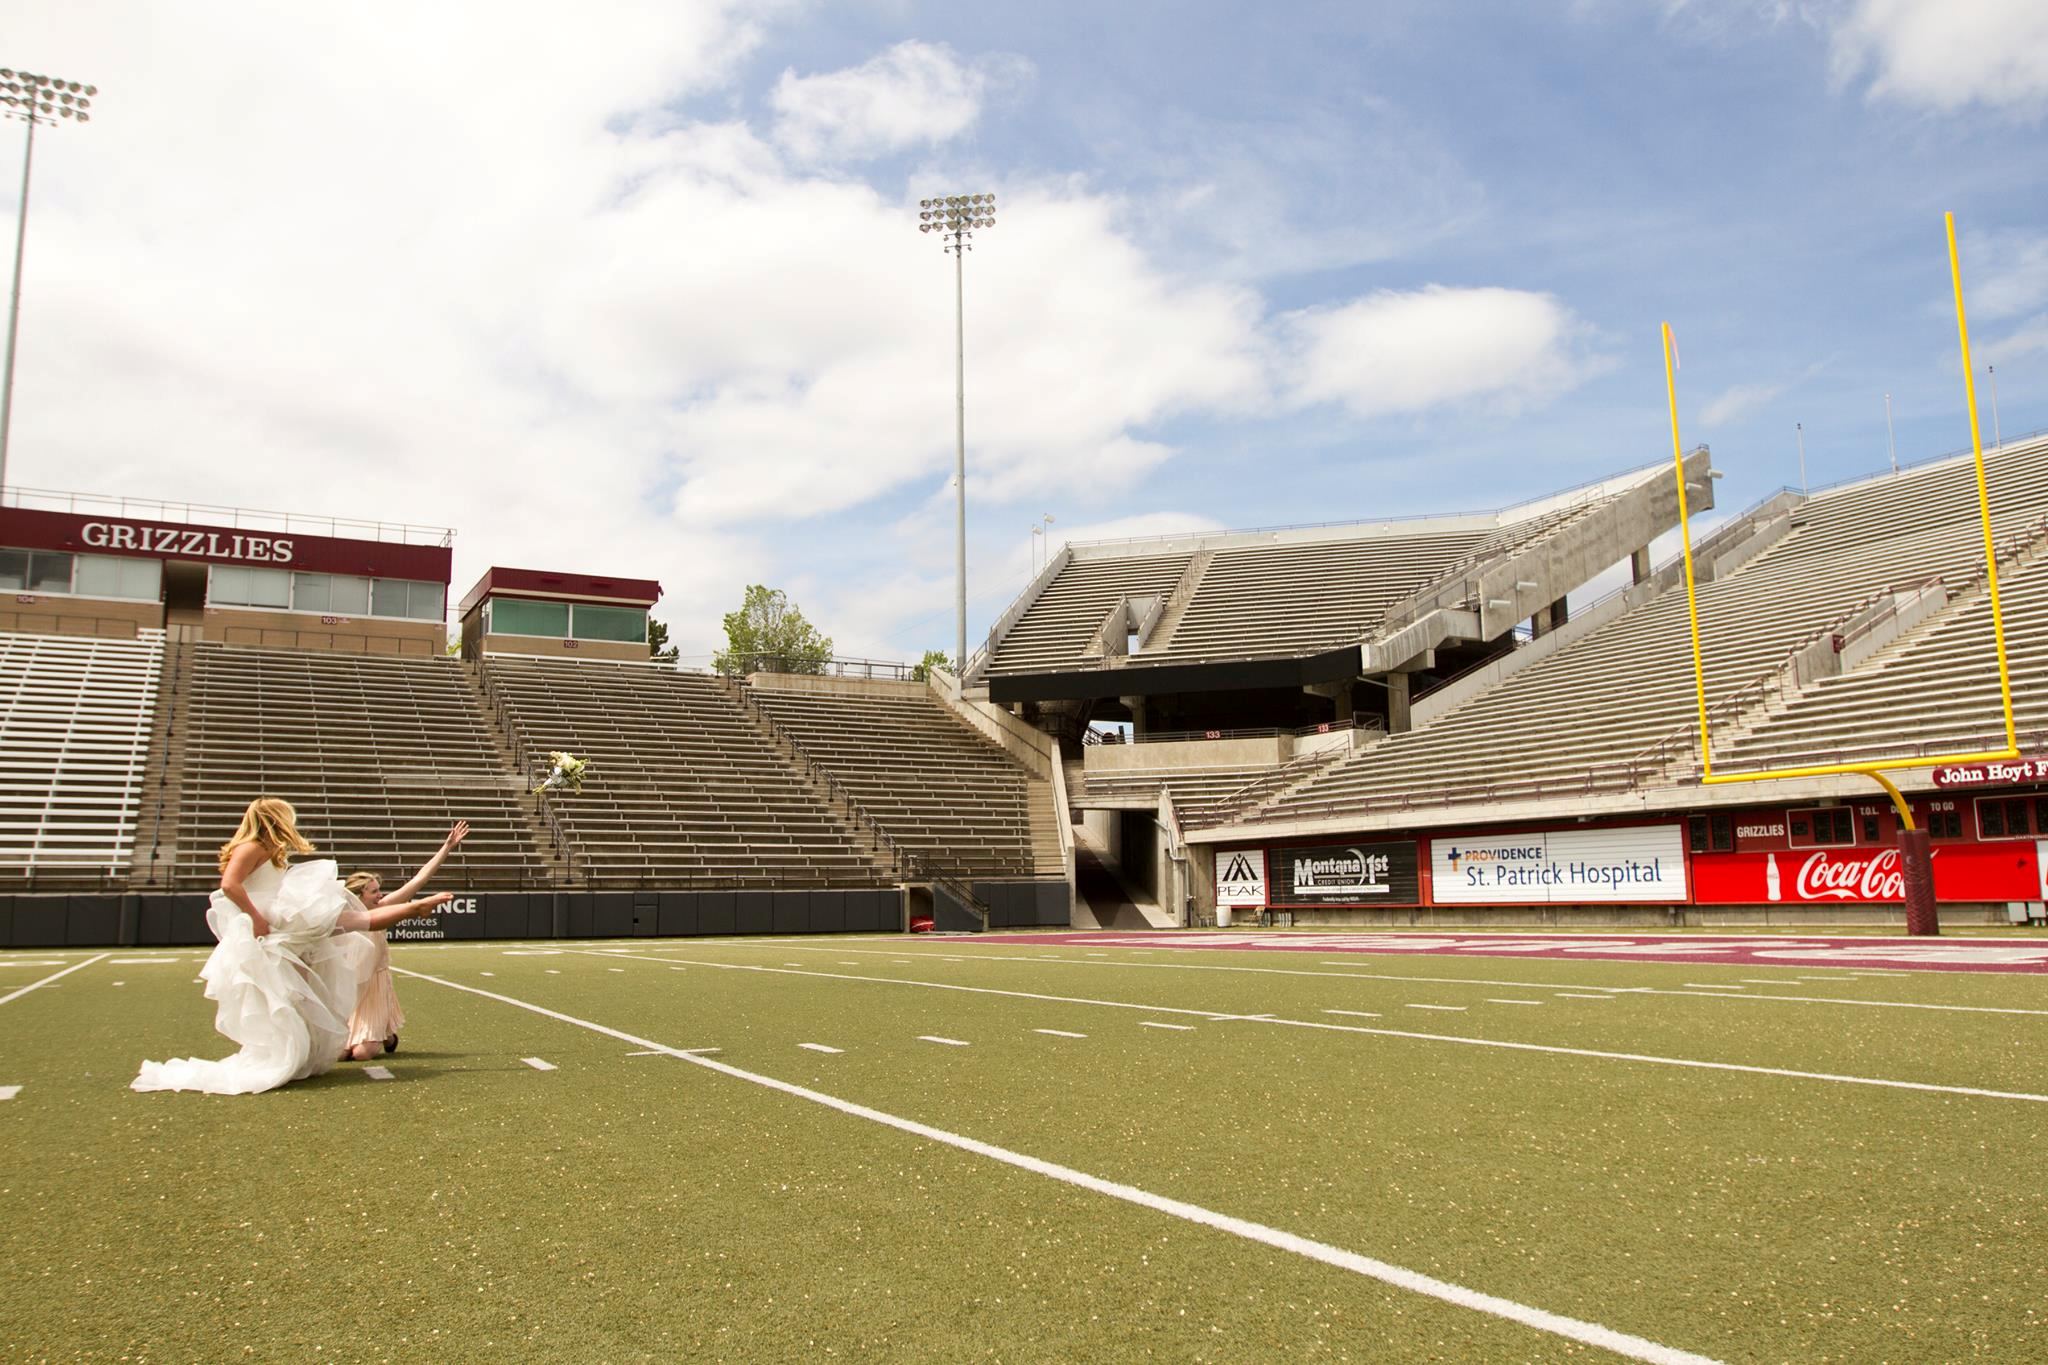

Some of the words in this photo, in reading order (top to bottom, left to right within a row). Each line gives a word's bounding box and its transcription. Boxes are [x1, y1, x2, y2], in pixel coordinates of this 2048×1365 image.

[81, 522, 294, 562] GRIZZLIES
[322, 617, 337, 625] 103
[1205, 730, 1221, 739] 133
[1318, 723, 1329, 733] 133
[1940, 767, 1984, 783] John
[1987, 762, 2032, 782] Hoyt
[1930, 802, 1941, 812] TO
[1943, 802, 1955, 811] GO
[1737, 824, 1784, 838] GRIZZLIES
[1465, 847, 1543, 861] PROVIDENCE
[1294, 857, 1360, 886] Montana
[1366, 855, 1389, 884] 1st
[1467, 866, 1490, 886] St.
[1497, 861, 1563, 886] Patrick
[1570, 858, 1662, 890] Hospital
[1796, 849, 1905, 900] Coca-Co
[1217, 885, 1264, 897] PEAK
[395, 929, 444, 939] Montana
